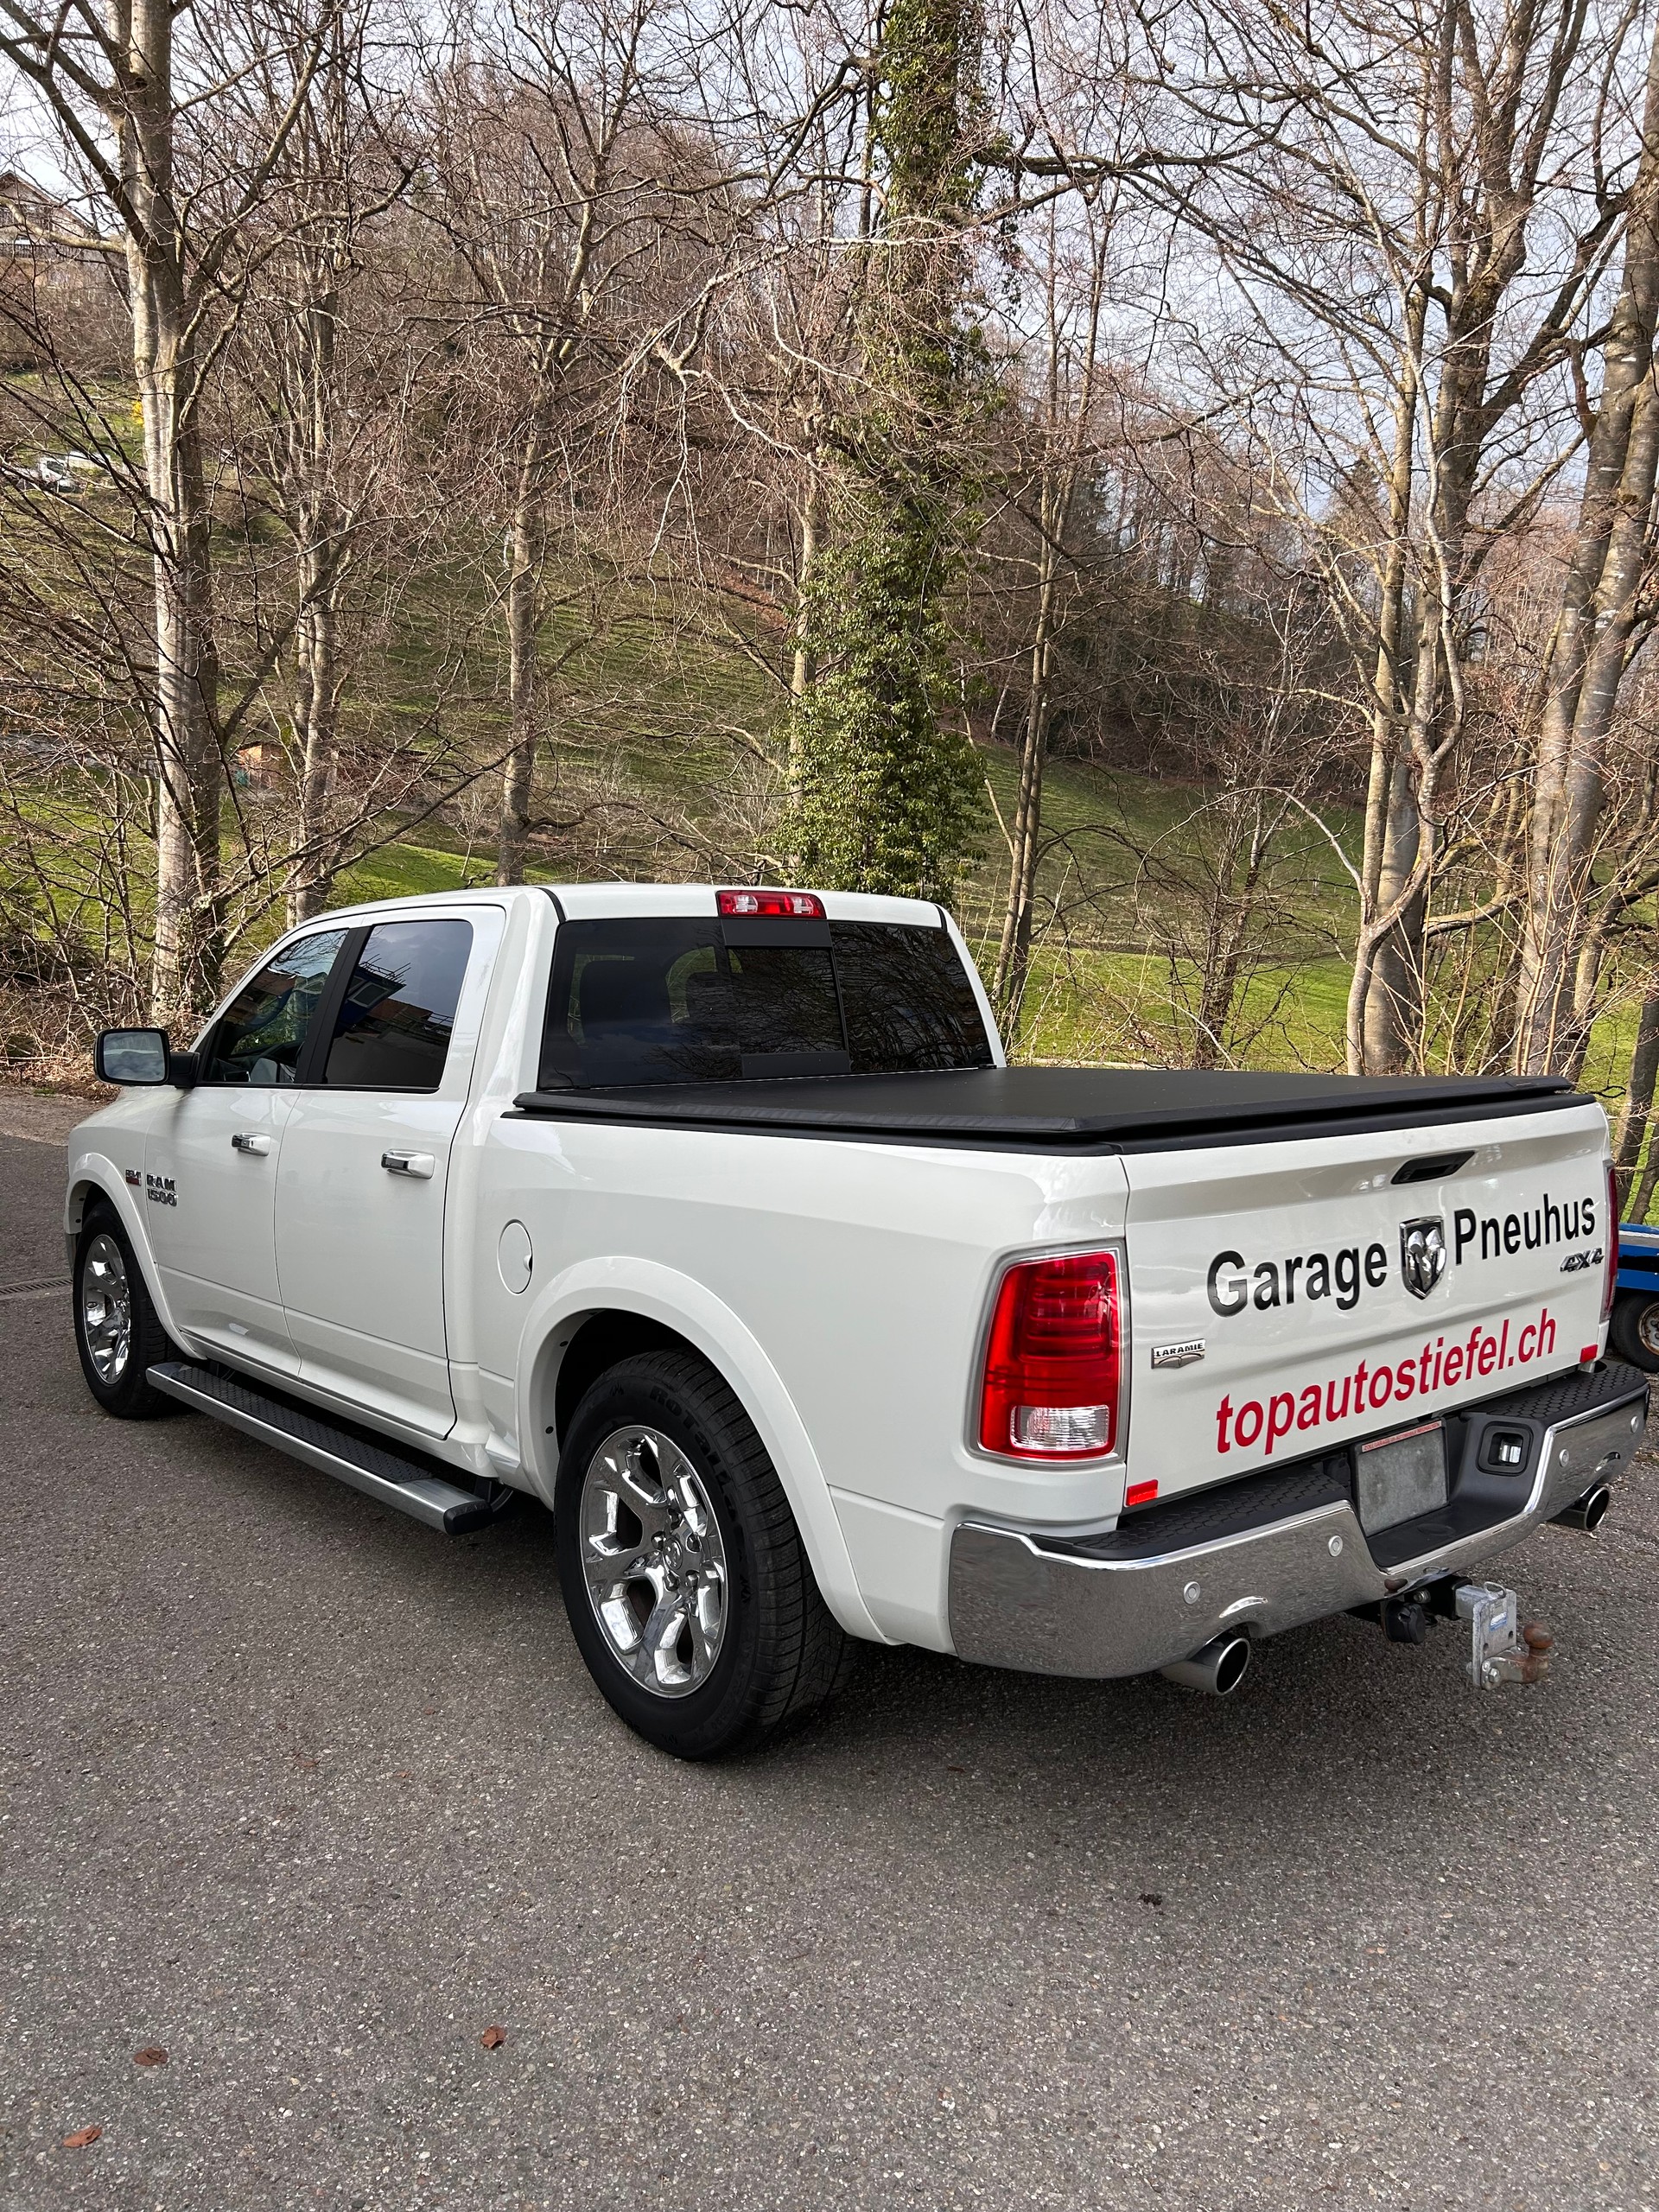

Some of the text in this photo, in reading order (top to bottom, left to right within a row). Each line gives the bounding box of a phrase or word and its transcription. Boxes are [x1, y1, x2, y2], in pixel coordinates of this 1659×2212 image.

[147, 1173, 176, 1192] RAM
[1208, 1194, 1595, 1317] Garage Pneuhus
[1155, 1342, 1204, 1357] LARAMIE
[1217, 1308, 1556, 1456] topautostiefel.ch
